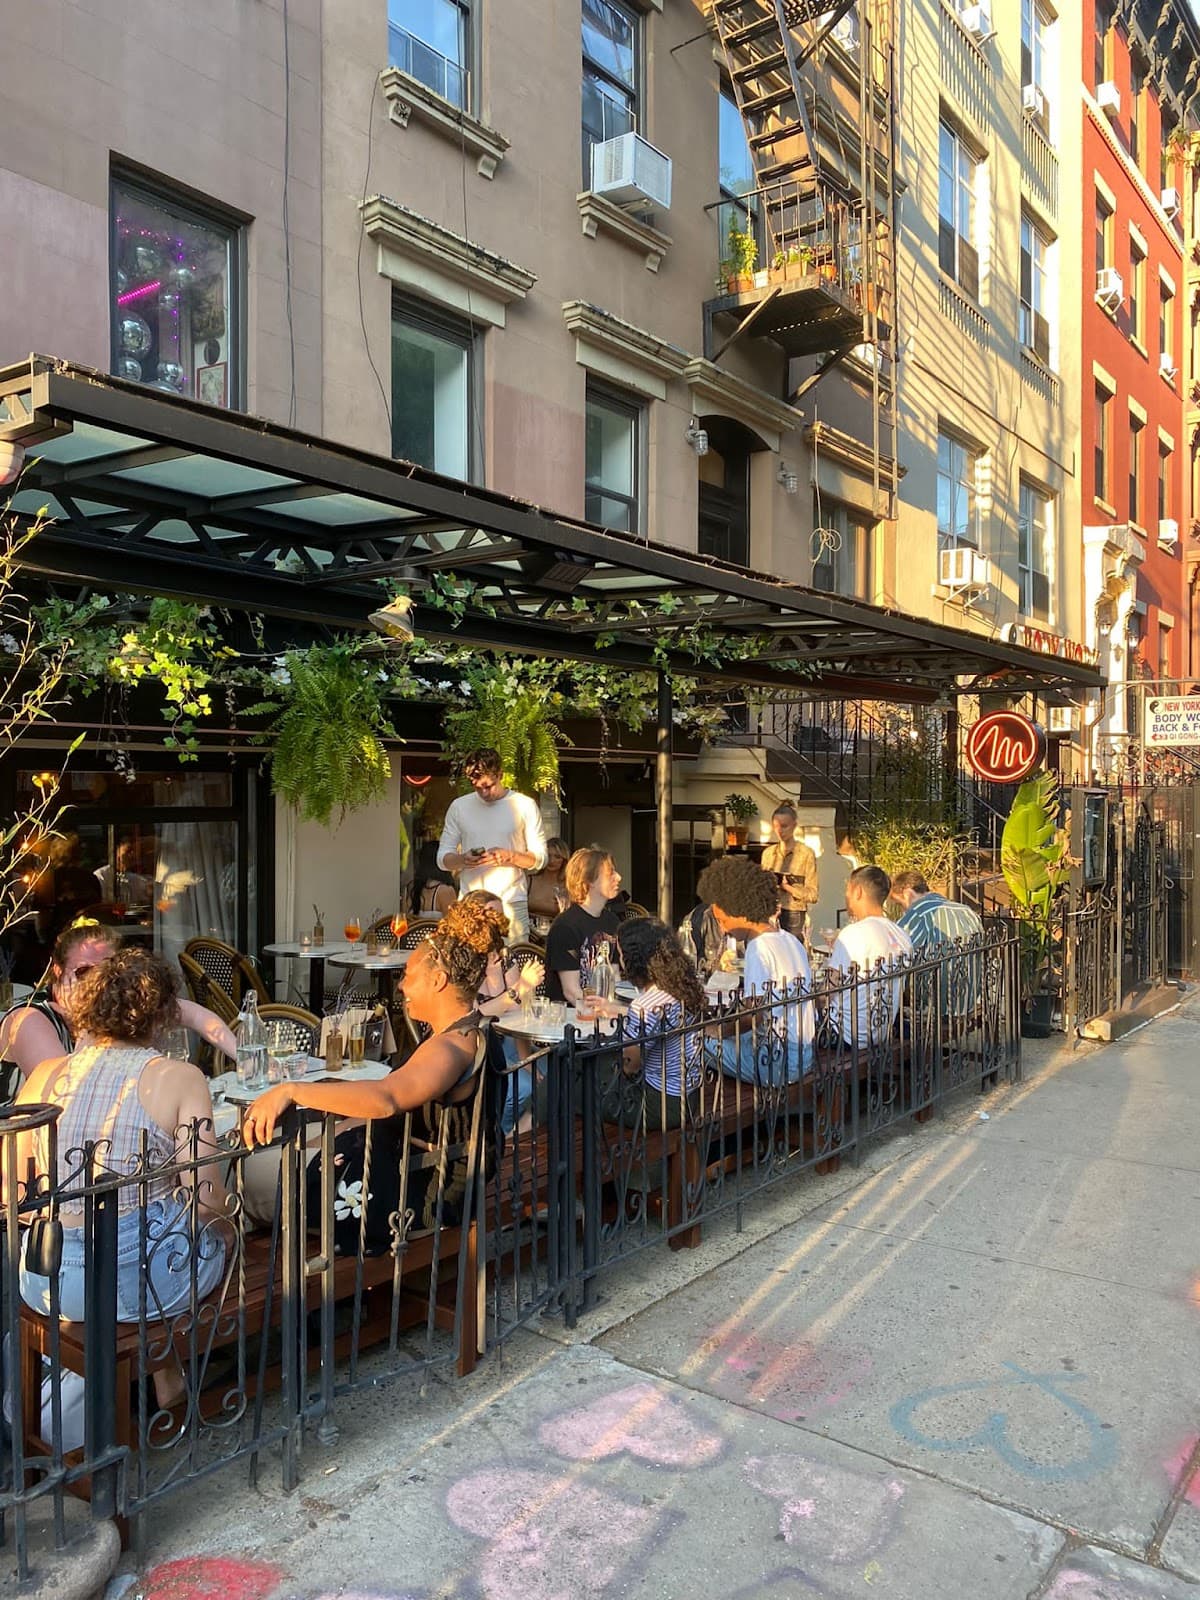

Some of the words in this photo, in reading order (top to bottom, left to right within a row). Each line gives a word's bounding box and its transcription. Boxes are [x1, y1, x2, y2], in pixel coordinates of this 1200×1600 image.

[1164, 702, 1180, 712] NEW
[1155, 713, 1182, 723] BODY
[1152, 723, 1178, 732] BACK
[1182, 723, 1189, 731] &
[1193, 722, 1200, 731] F
